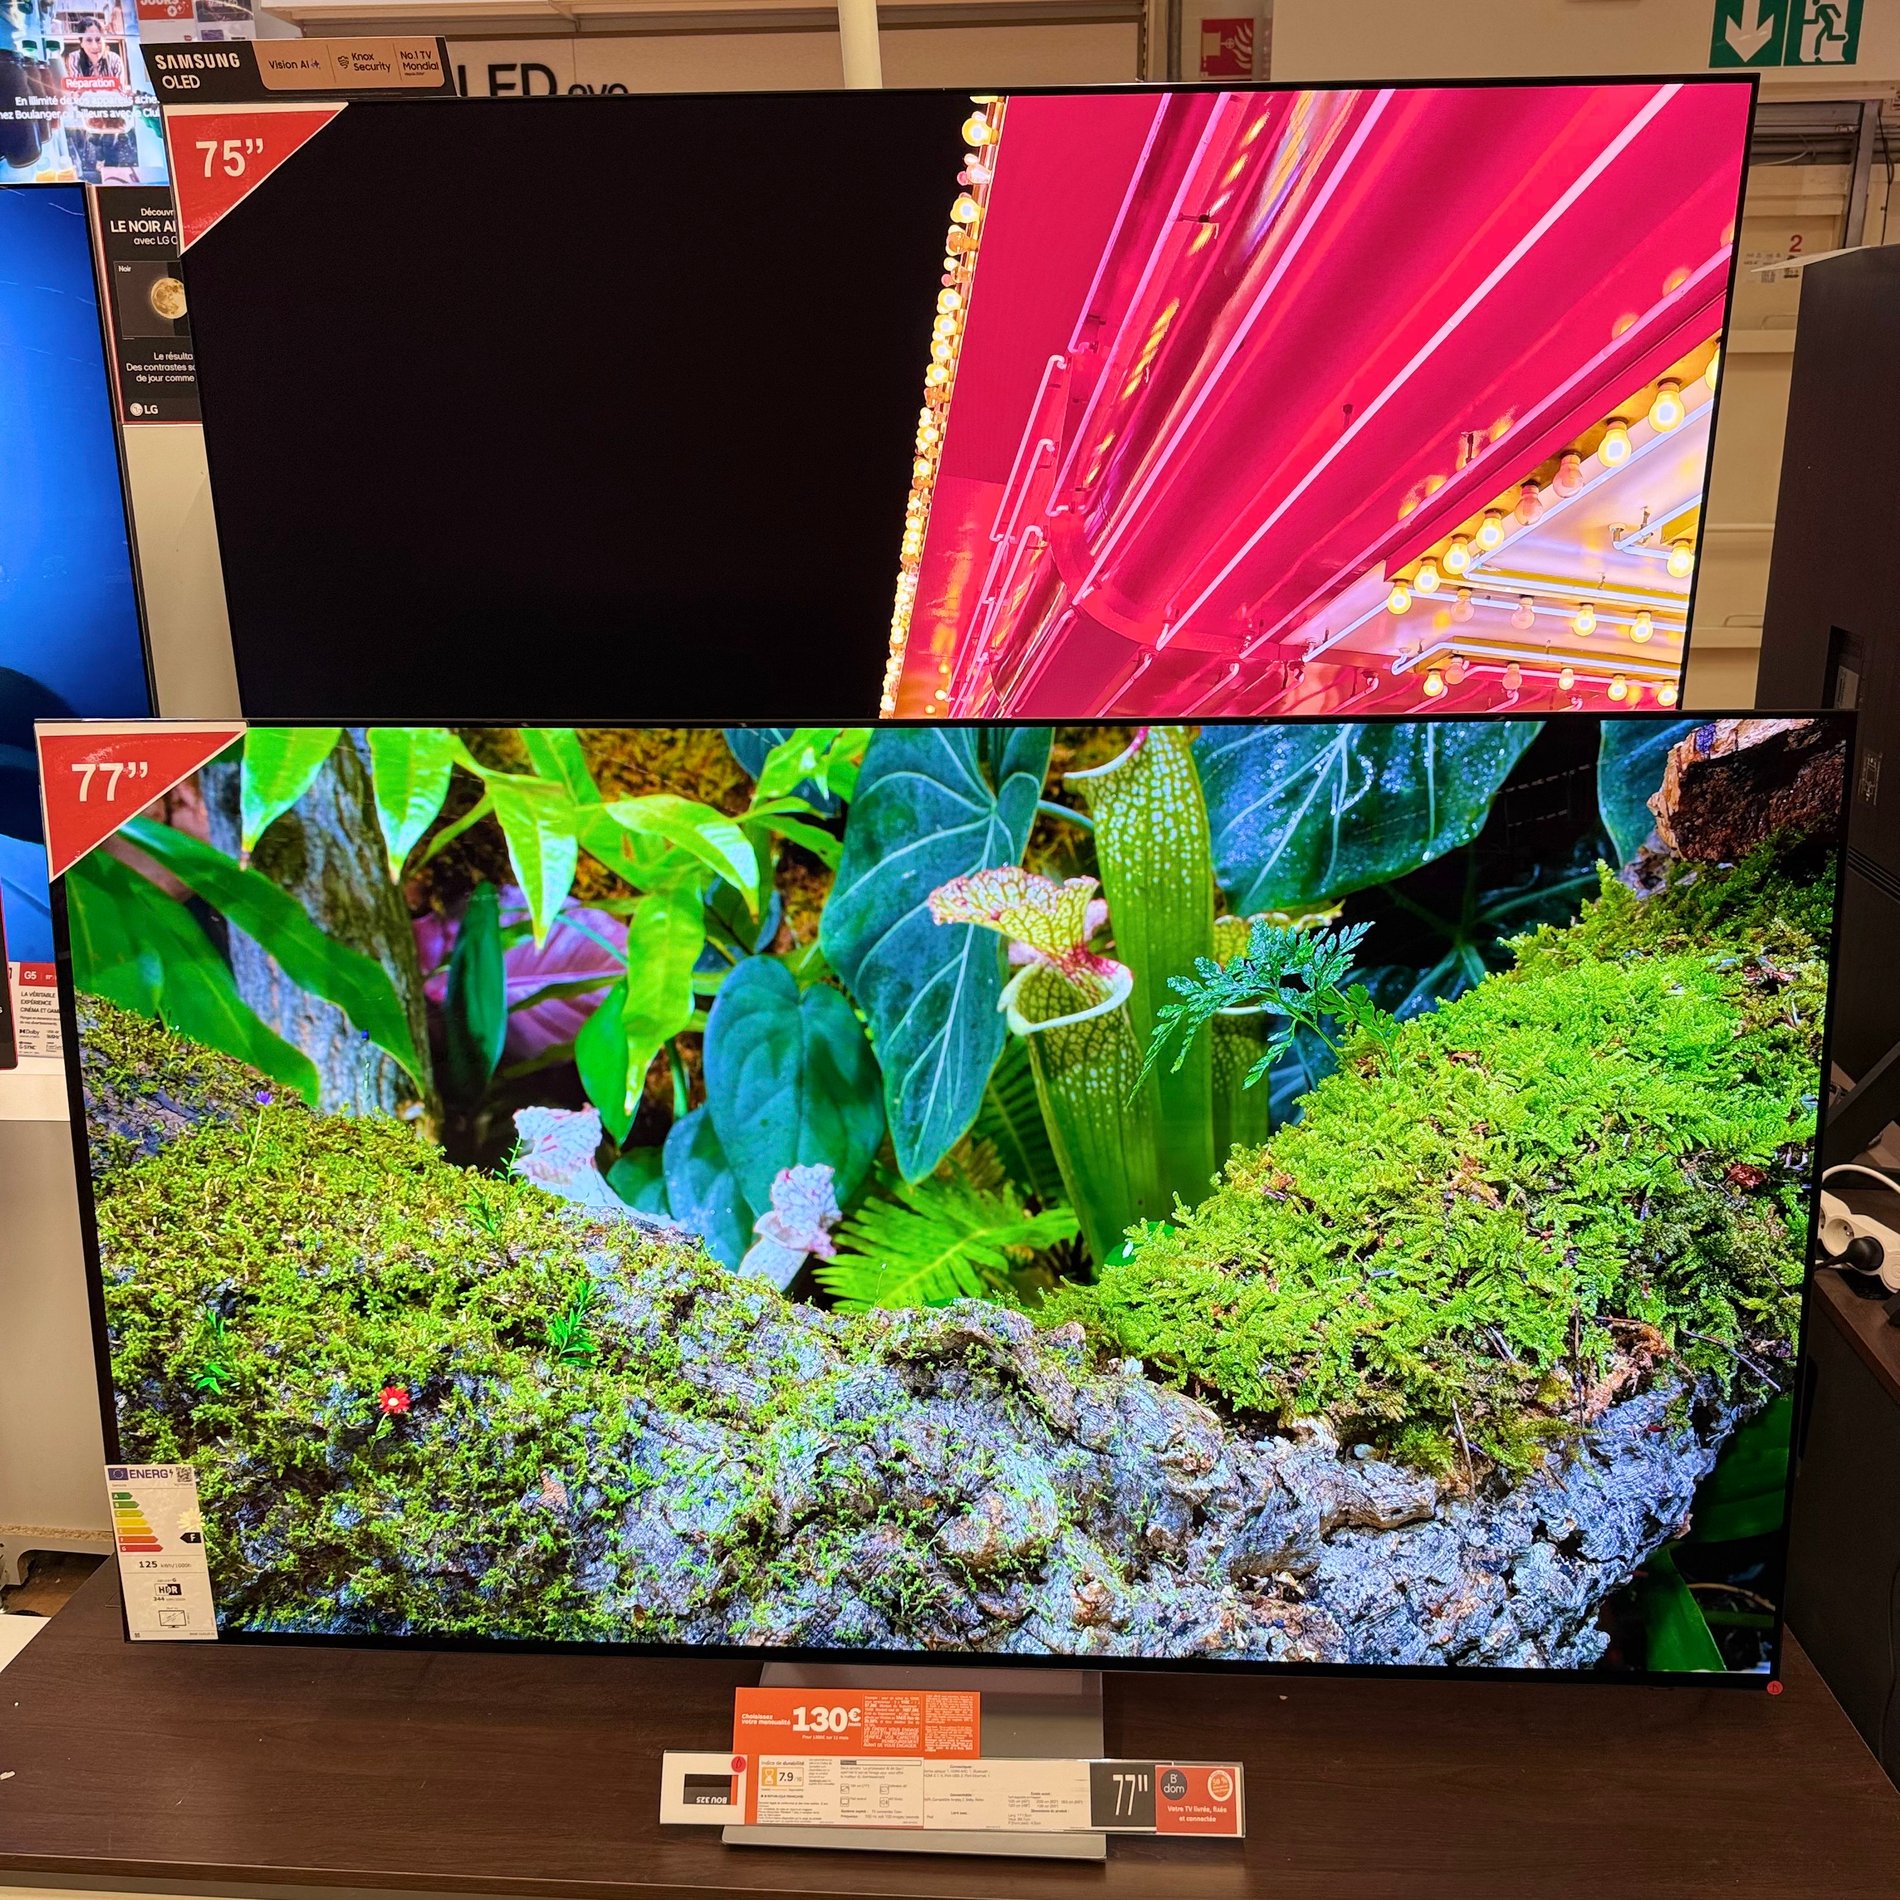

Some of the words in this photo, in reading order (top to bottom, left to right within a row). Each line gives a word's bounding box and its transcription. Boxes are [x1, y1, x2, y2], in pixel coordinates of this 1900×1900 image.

[351, 52, 375, 61] Knox
[419, 51, 432, 60] TV
[155, 53, 241, 70] SAMSUNG
[269, 60, 298, 70] Vision
[403, 61, 440, 71] Mondial
[354, 62, 391, 73] Security
[66, 78, 116, 89] Réparation
[162, 75, 201, 89] OLED
[15, 97, 27, 106] En
[135, 95, 160, 105] ache
[15, 110, 61, 121] Boulanger
[110, 220, 127, 233] LE
[128, 220, 161, 233] NOIR
[133, 237, 156, 245] avec
[156, 236, 170, 245] LG
[1789, 234, 1803, 253] 2
[153, 352, 165, 361] Le
[126, 363, 143, 371] Des
[136, 374, 147, 382] de
[147, 374, 163, 384] jour
[144, 404, 159, 415] LG
[24, 970, 37, 980] G5
[129, 1469, 169, 1479] ENERG
[139, 1561, 158, 1569] 125
[158, 1586, 178, 1594] HDR
[779, 1772, 794, 1782] 7.9
[1163, 1784, 1185, 1794] dom
[1167, 1805, 1184, 1813] Votre
[1184, 1805, 1193, 1813] TV
